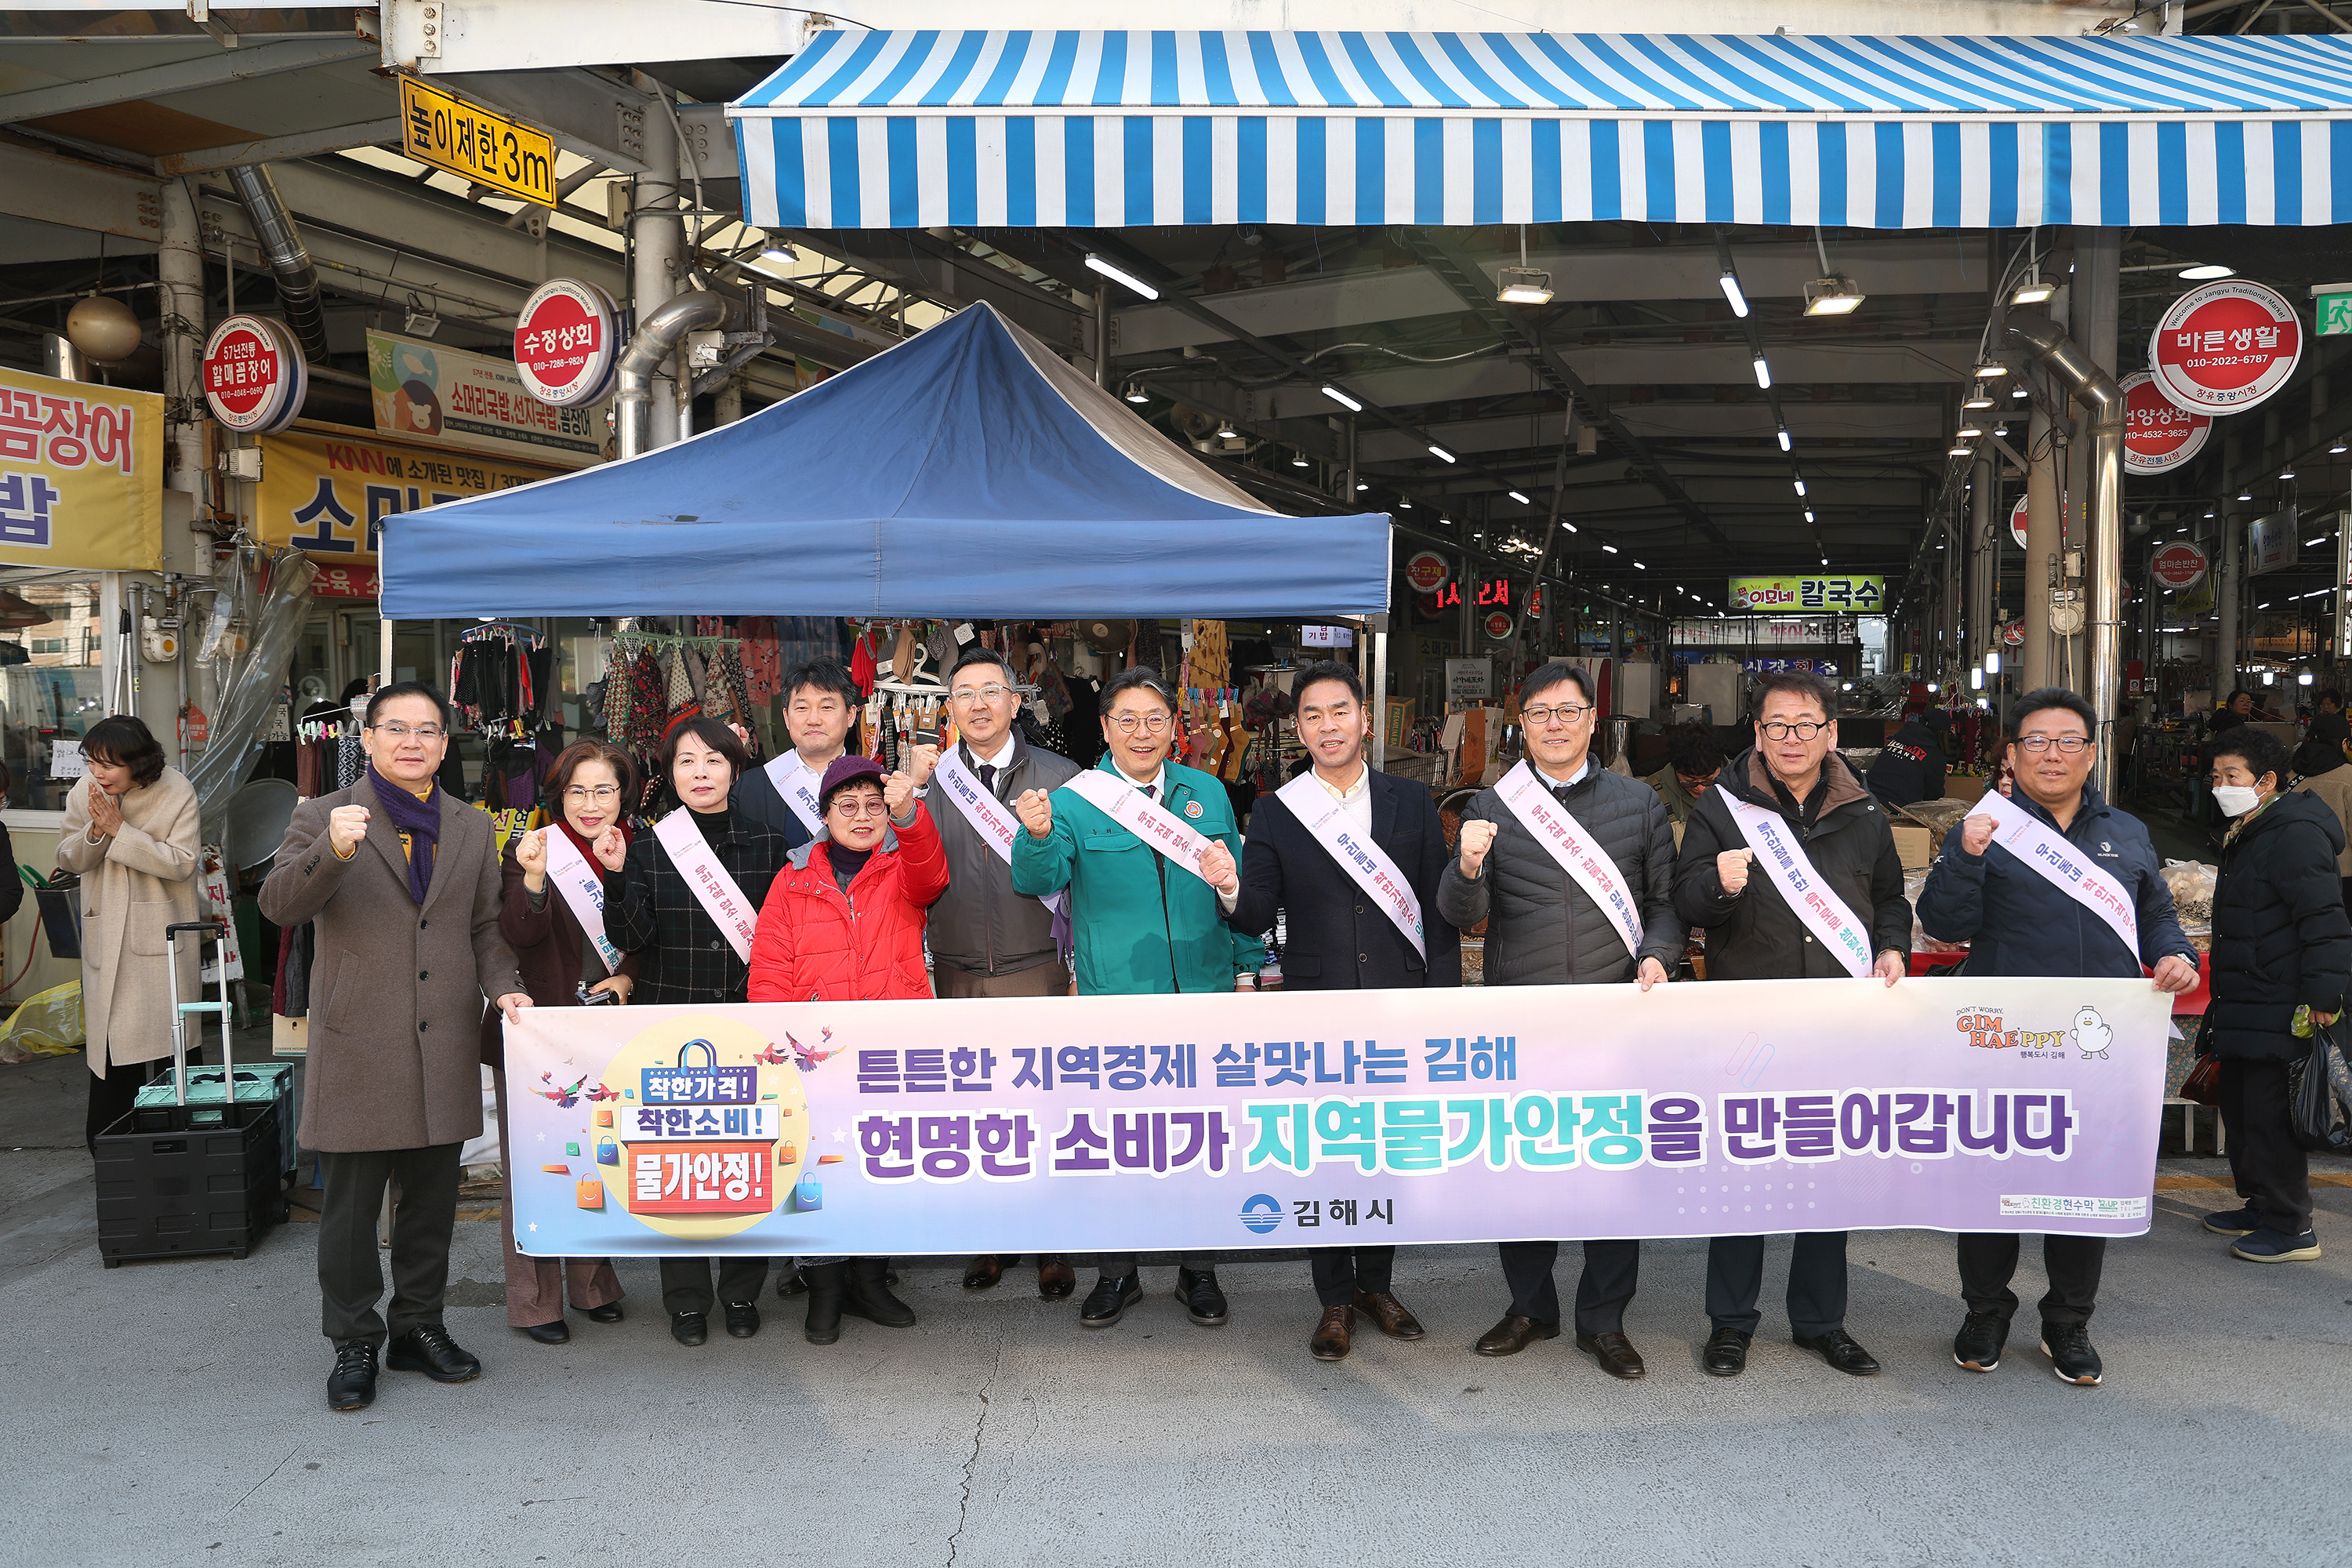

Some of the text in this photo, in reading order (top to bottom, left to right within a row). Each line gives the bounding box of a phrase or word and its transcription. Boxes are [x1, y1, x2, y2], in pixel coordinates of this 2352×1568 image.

[523, 299, 539, 323] Welcome
[543, 285, 559, 296] Jangyu
[558, 285, 581, 300] Traditional
[579, 294, 592, 311] Market
[2170, 300, 2194, 327] Welcome
[2204, 288, 2230, 299] Jangyu
[2231, 286, 2268, 301] Traditional
[2267, 298, 2286, 319] Market
[223, 341, 256, 361] 57년전통
[524, 323, 593, 355] 수정상회
[2177, 325, 2281, 353] 바른생활
[212, 358, 270, 387] 할매꼼장어
[533, 356, 584, 372] 010-7288-9824
[2186, 354, 2269, 368] 010-2022-6787
[539, 381, 579, 398] 장유중앙시장
[2196, 384, 2257, 402] 장유중앙시장
[2130, 451, 2180, 465] 장유전통시장
[407, 460, 453, 486] 소개된
[456, 466, 486, 490] 맛집
[2158, 560, 2198, 569] 엄마손반찬
[1749, 580, 1881, 608] 이모네 칼국수
[1392, 707, 1401, 735] PREMIUM
[1887, 746, 1916, 760] JEANS
[947, 768, 978, 805] 우리동네
[1137, 811, 1157, 829] 우리
[1154, 822, 1174, 840] 지역
[1531, 804, 1552, 823] 우리
[1545, 819, 1567, 840] 지역
[1609, 889, 1625, 911] 이용
[695, 864, 713, 884] 우리
[706, 880, 726, 901] 지역
[1336, 832, 1377, 875] 우리동네
[1373, 871, 1417, 927] 착한가격업소
[1756, 821, 1795, 870] 물가안정을
[1787, 868, 1810, 893] 위한
[1804, 891, 1844, 931] 슬기로운
[2034, 842, 2137, 936] 우리동네 착한가격업소
[1957, 1014, 2002, 1033] GIM
[856, 1036, 1517, 1094] 튼튼한 지역경제 살맛나는 김해
[648, 1076, 749, 1102] 착한가격!
[637, 1108, 763, 1137] 착한소비!
[858, 1093, 2072, 1178] 현명한 소비가 지역물가안정을 만들어갑니다
[637, 1152, 763, 1202] 물가안정!
[1293, 1198, 1396, 1228] 김해시
[2031, 1197, 2094, 1211] 친환경현수막
